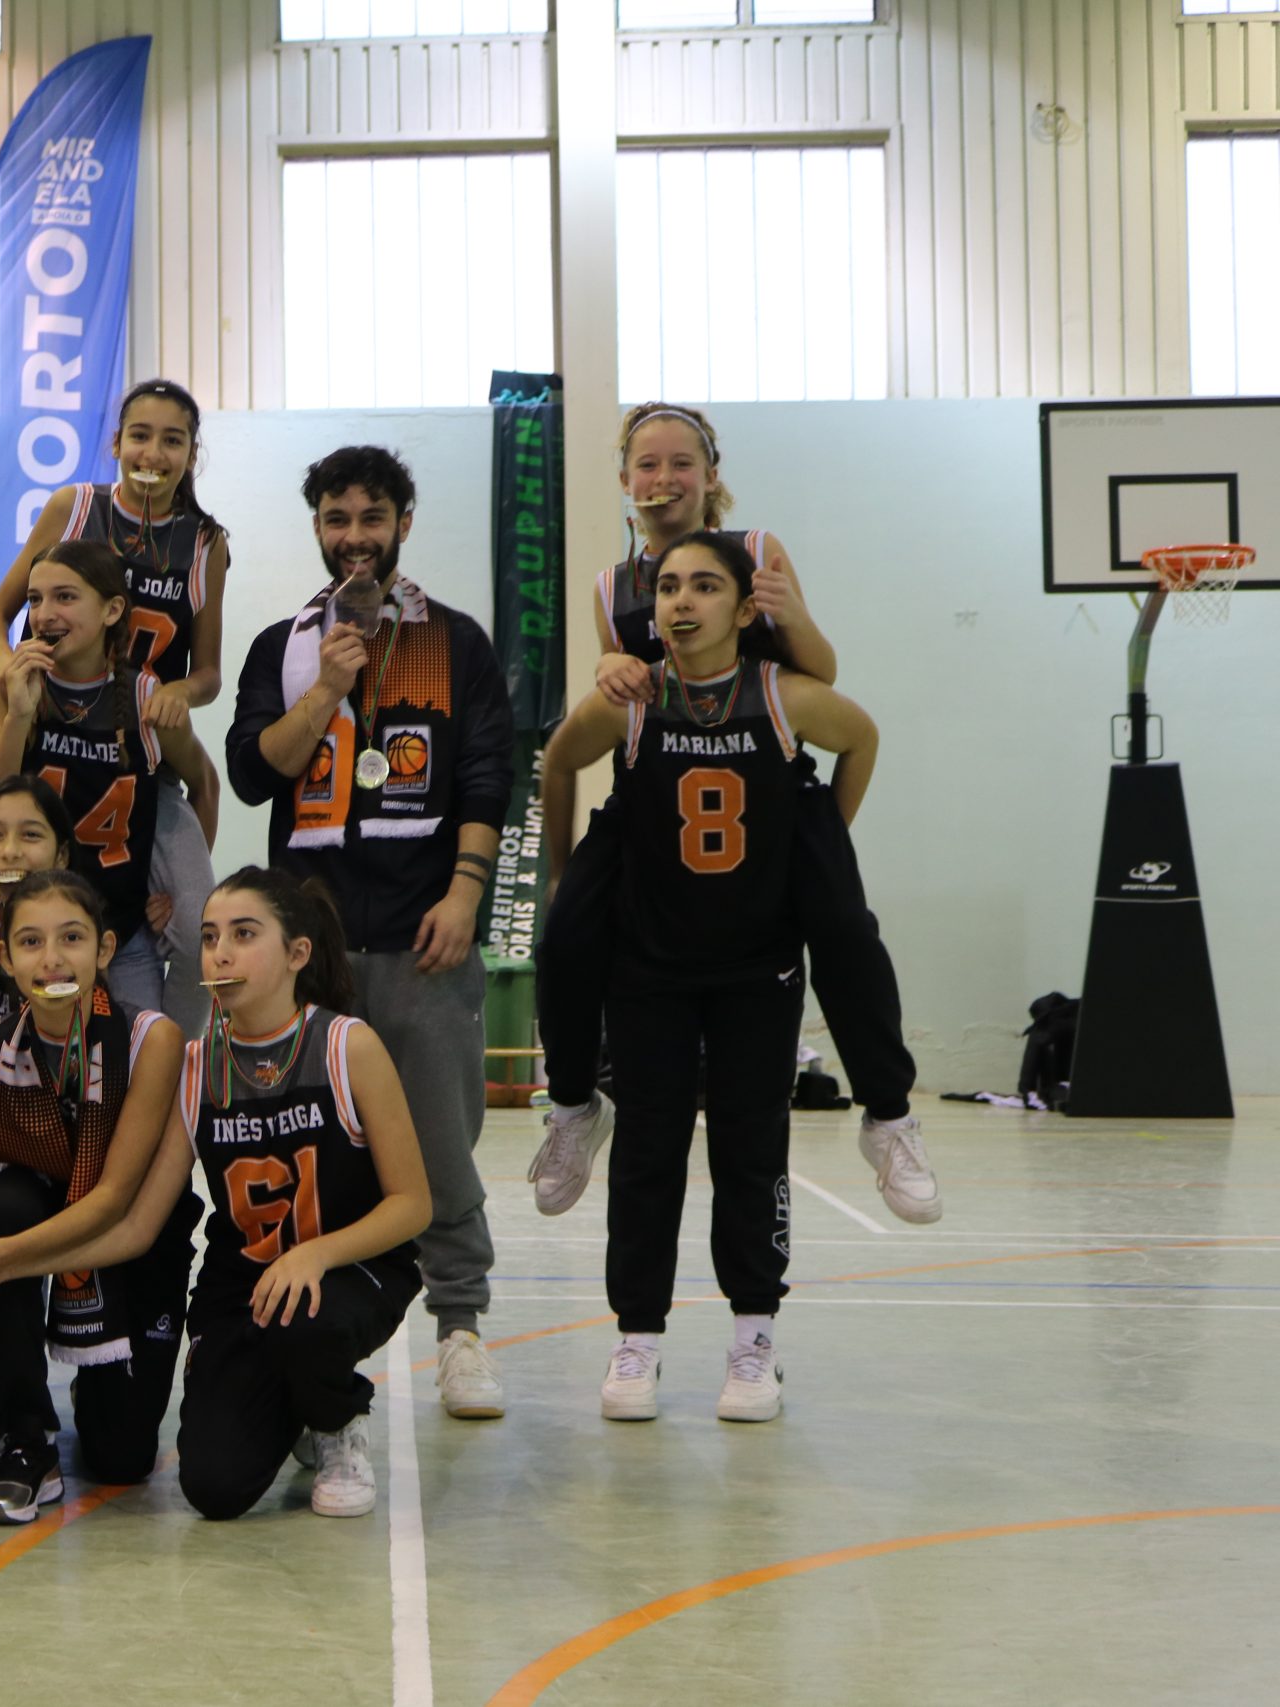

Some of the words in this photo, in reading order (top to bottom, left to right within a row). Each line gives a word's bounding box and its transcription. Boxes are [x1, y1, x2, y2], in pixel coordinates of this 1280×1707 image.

[41, 137, 96, 160] MIR
[37, 159, 105, 182] AND
[34, 182, 92, 206] ELA
[515, 418, 547, 638] DAUPHIN
[138, 577, 183, 600] JOÃO
[41, 731, 120, 763] MATILDE
[662, 731, 758, 757] MARIANA
[678, 767, 745, 874] 8
[517, 871, 537, 886] &
[213, 1112, 263, 1143] INÊS
[267, 1102, 325, 1137] VEIGA
[223, 1145, 324, 1263] 61
